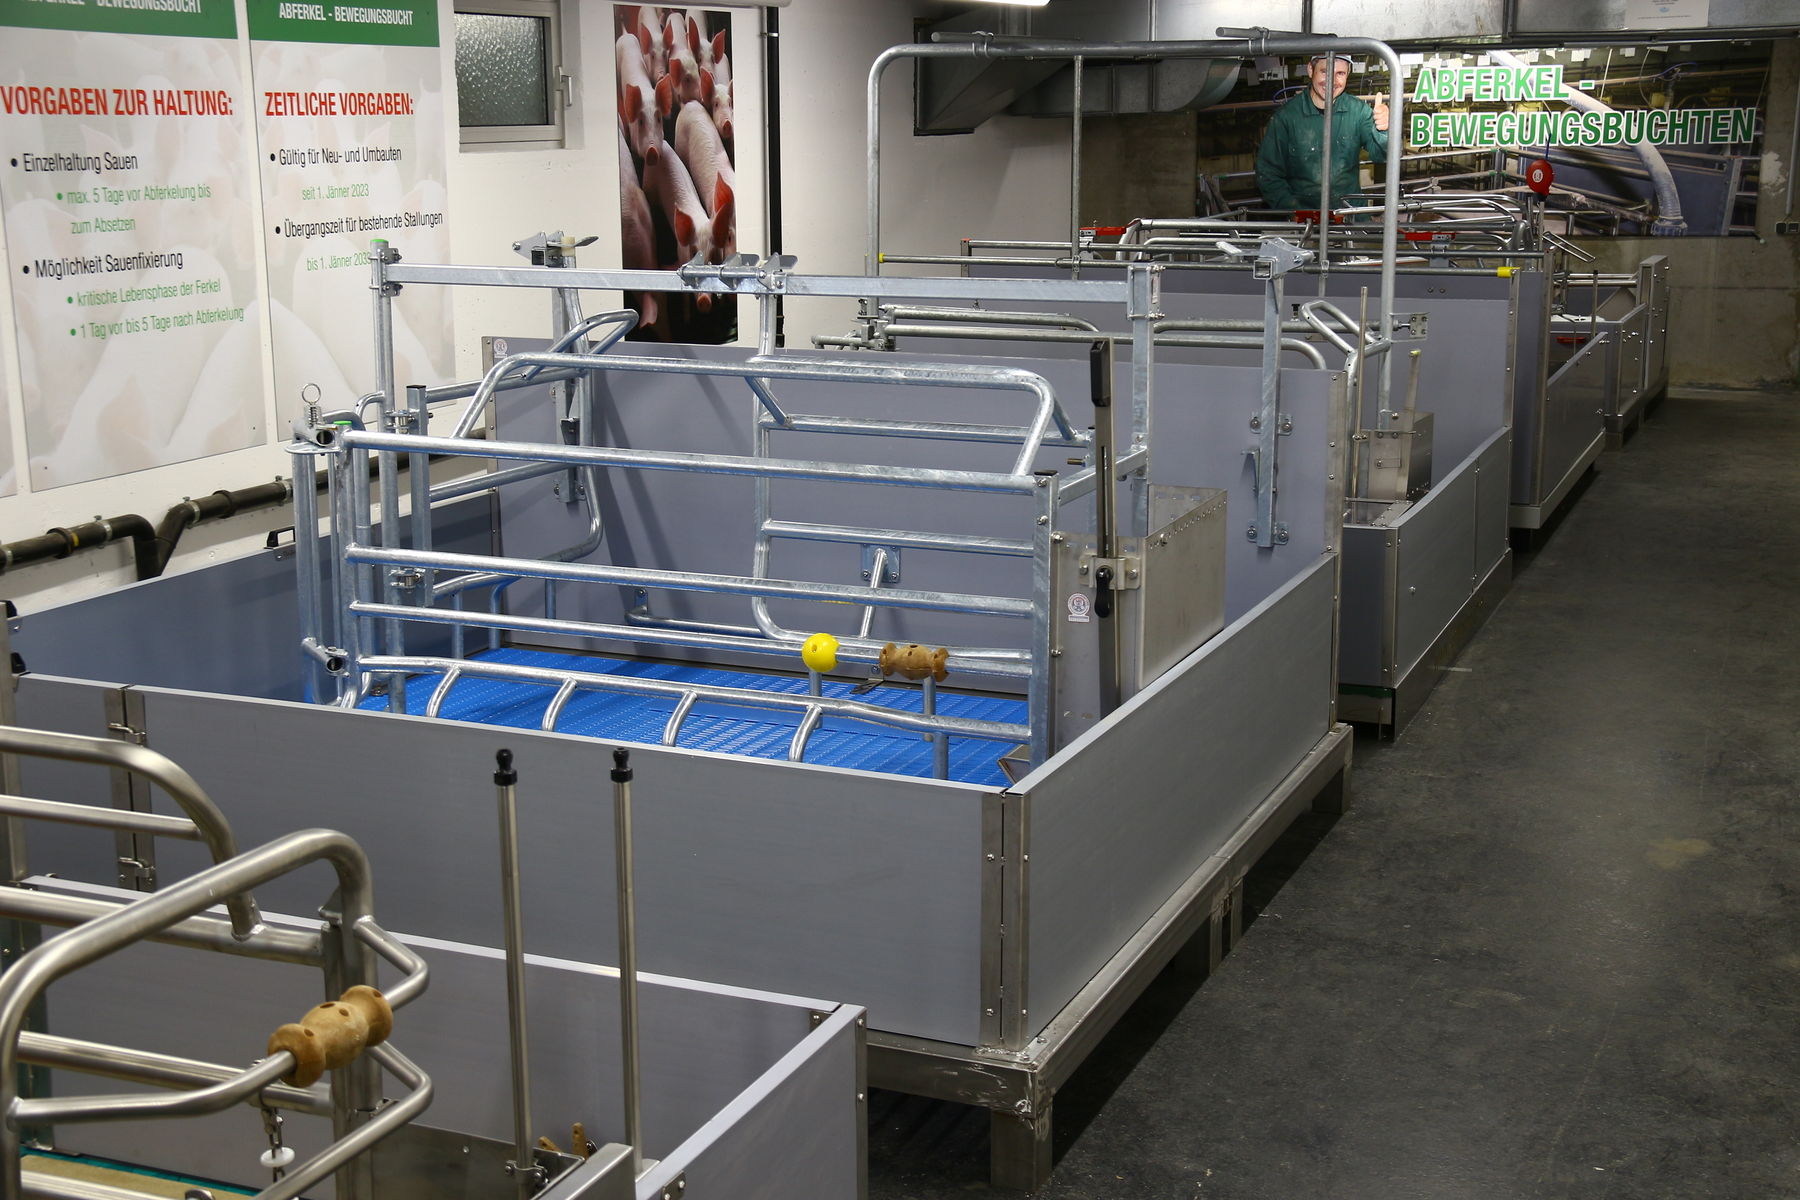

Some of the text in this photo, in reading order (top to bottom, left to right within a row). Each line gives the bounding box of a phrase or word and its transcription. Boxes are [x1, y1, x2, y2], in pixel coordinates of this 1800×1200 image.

[279, 2, 326, 21] ABFERKEL
[334, 6, 413, 25] BEWEGUNGSBUCHT
[1413, 64, 1570, 103] ABFERKEL
[0, 86, 233, 116] VORGABEN ZUR HALTUNG:
[265, 92, 414, 116] ZEITLICHE VORGABEN:
[1410, 108, 1756, 147] BEWEGUNGSBUCHTEN
[23, 152, 139, 174] Einzelhaltung Sauen
[279, 147, 402, 168] Gültig für Neu- und Umbauten
[67, 184, 211, 206] max. 5 Tage vor Abferkelung bis
[302, 183, 370, 201] seit 1. Jänner 2023
[71, 217, 136, 235] zum Absetzen
[284, 211, 443, 239] Übergangszeit für bestehende Stallungen
[35, 251, 183, 280] Möglichkeit Sauenfixierung
[306, 258, 318, 272] bis
[320, 257, 328, 270] 1.
[328, 255, 352, 269] Jänner
[77, 279, 221, 307] kritische Lebensphase der Ferkel
[80, 306, 245, 340] 1 Tag vor bis 5 Tage nach Abferkelung
